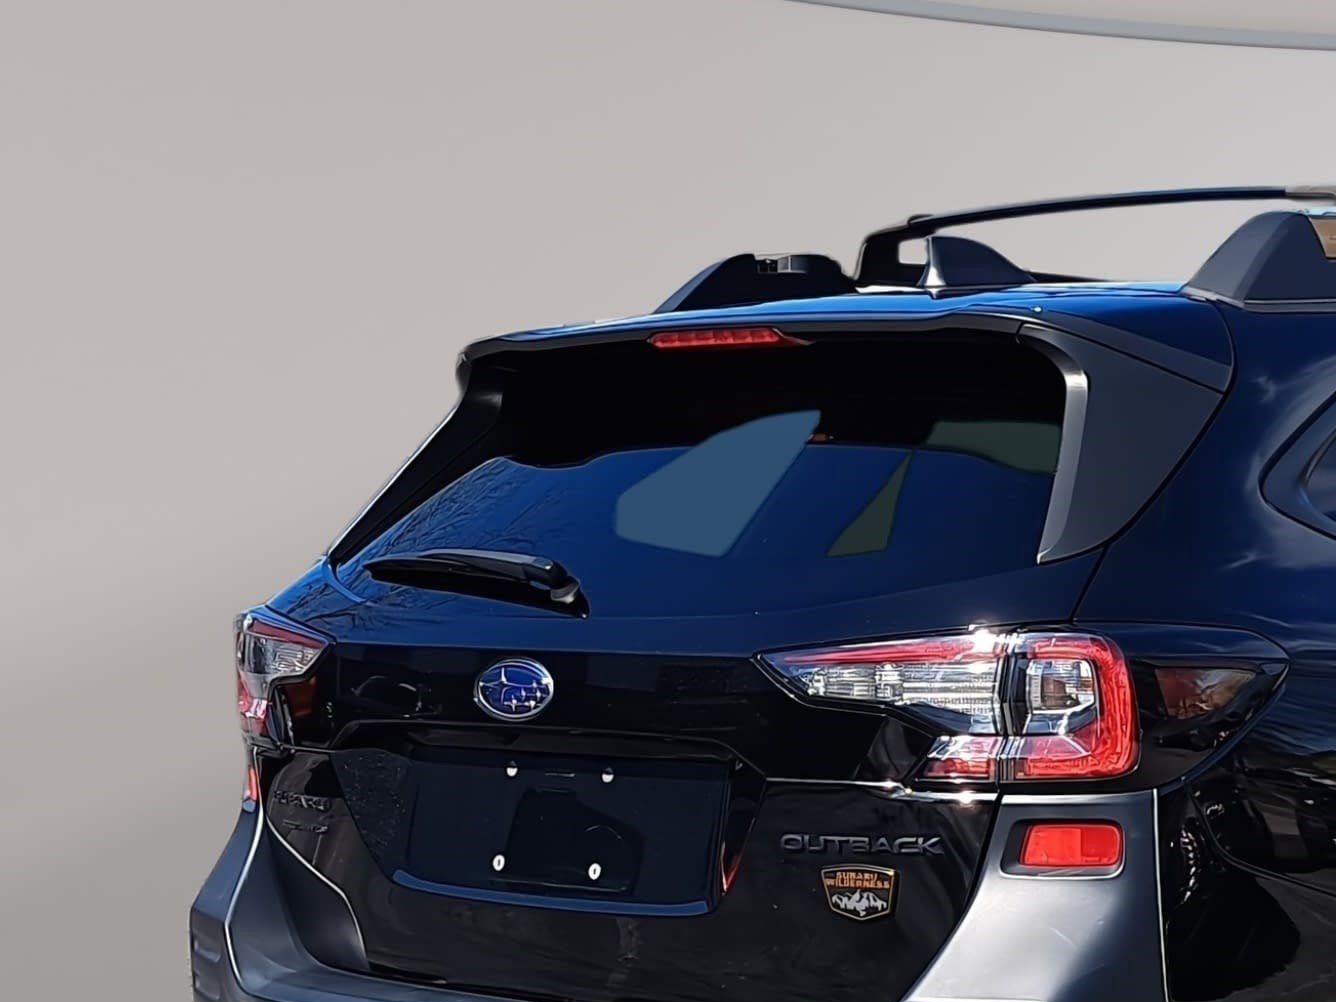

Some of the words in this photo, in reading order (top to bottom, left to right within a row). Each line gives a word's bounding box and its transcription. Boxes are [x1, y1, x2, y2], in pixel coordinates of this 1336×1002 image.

[780, 834, 944, 855] OUTBACK
[836, 871, 877, 881] SUBARU
[825, 879, 890, 889] WILDERNESS
